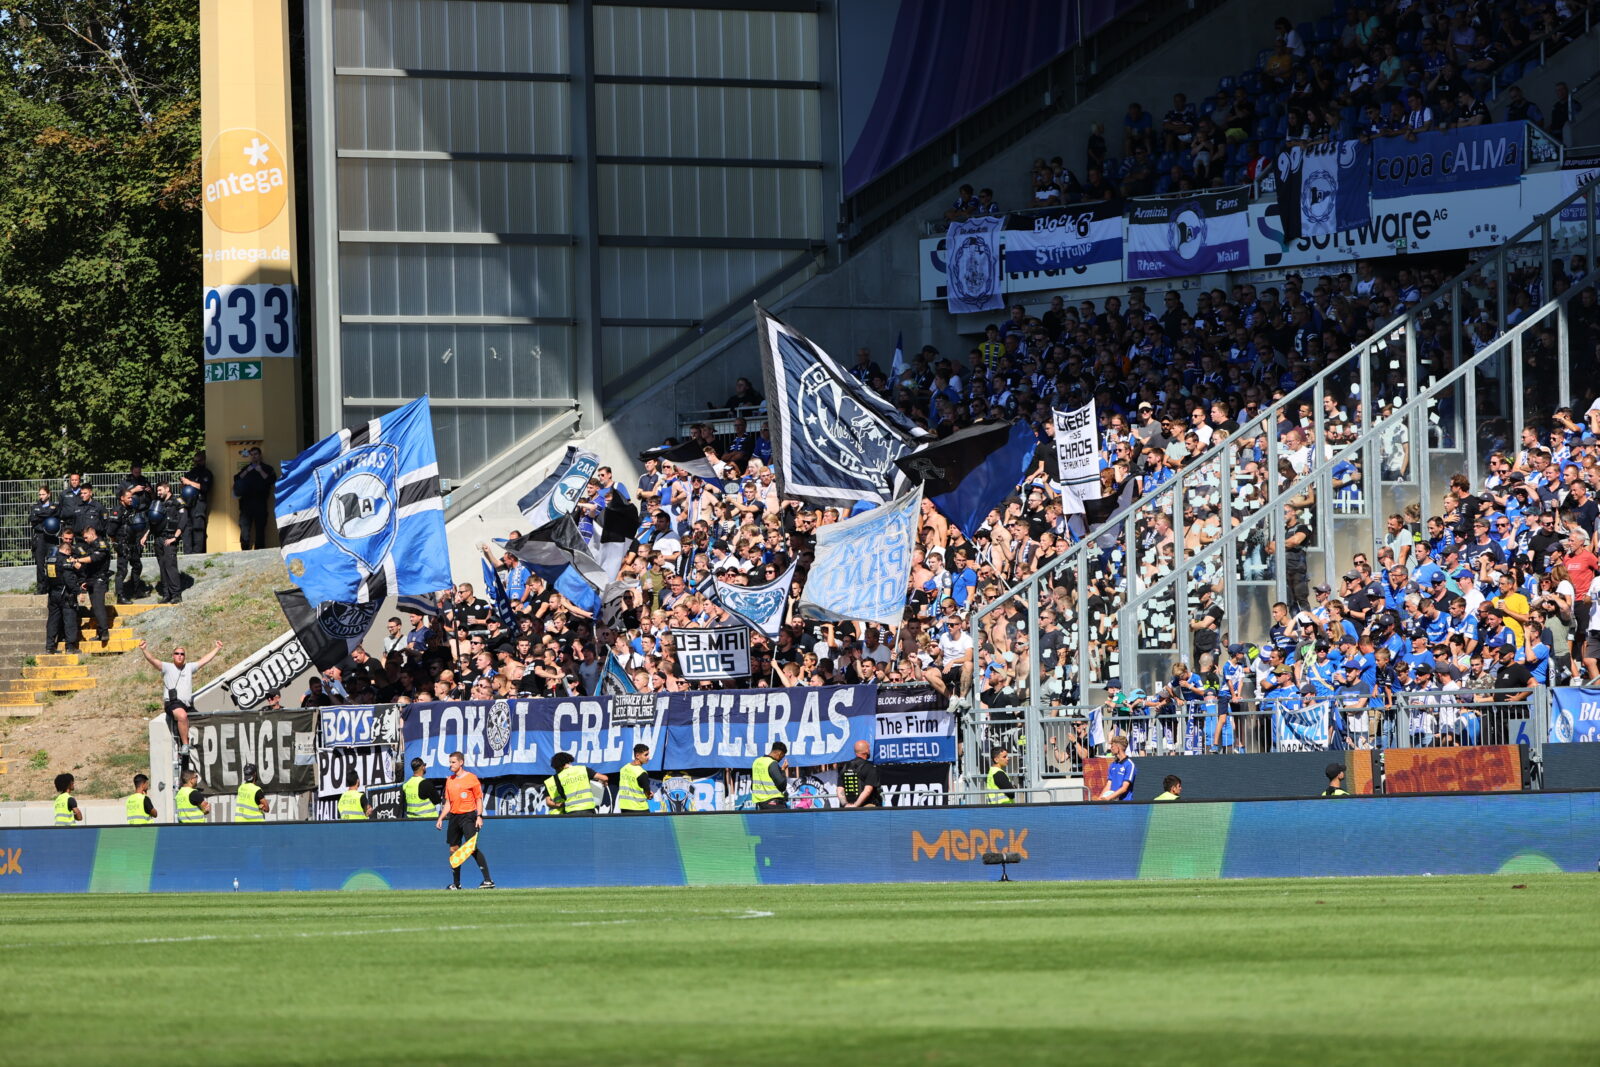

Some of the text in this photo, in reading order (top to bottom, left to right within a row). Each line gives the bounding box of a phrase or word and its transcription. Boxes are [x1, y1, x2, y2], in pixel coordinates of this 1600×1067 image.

[1376, 153, 1434, 186] copa
[205, 167, 284, 203] entega
[1134, 198, 1239, 219] Arminia Fans
[1433, 208, 1448, 221] AG
[214, 245, 290, 263] entega.de
[1216, 248, 1240, 263] Main
[1057, 408, 1090, 431] LIEBE
[673, 631, 745, 651] 03.MAI
[230, 637, 311, 708] SAMS
[685, 653, 735, 674] 1905
[878, 696, 897, 706] BLOCK
[904, 695, 923, 704] SINCE
[322, 710, 373, 744] BOYS
[690, 686, 855, 757] ULTRAS
[877, 715, 939, 736] The Firm
[1515, 721, 1530, 744] 6
[879, 742, 940, 759] BIELEFELD
